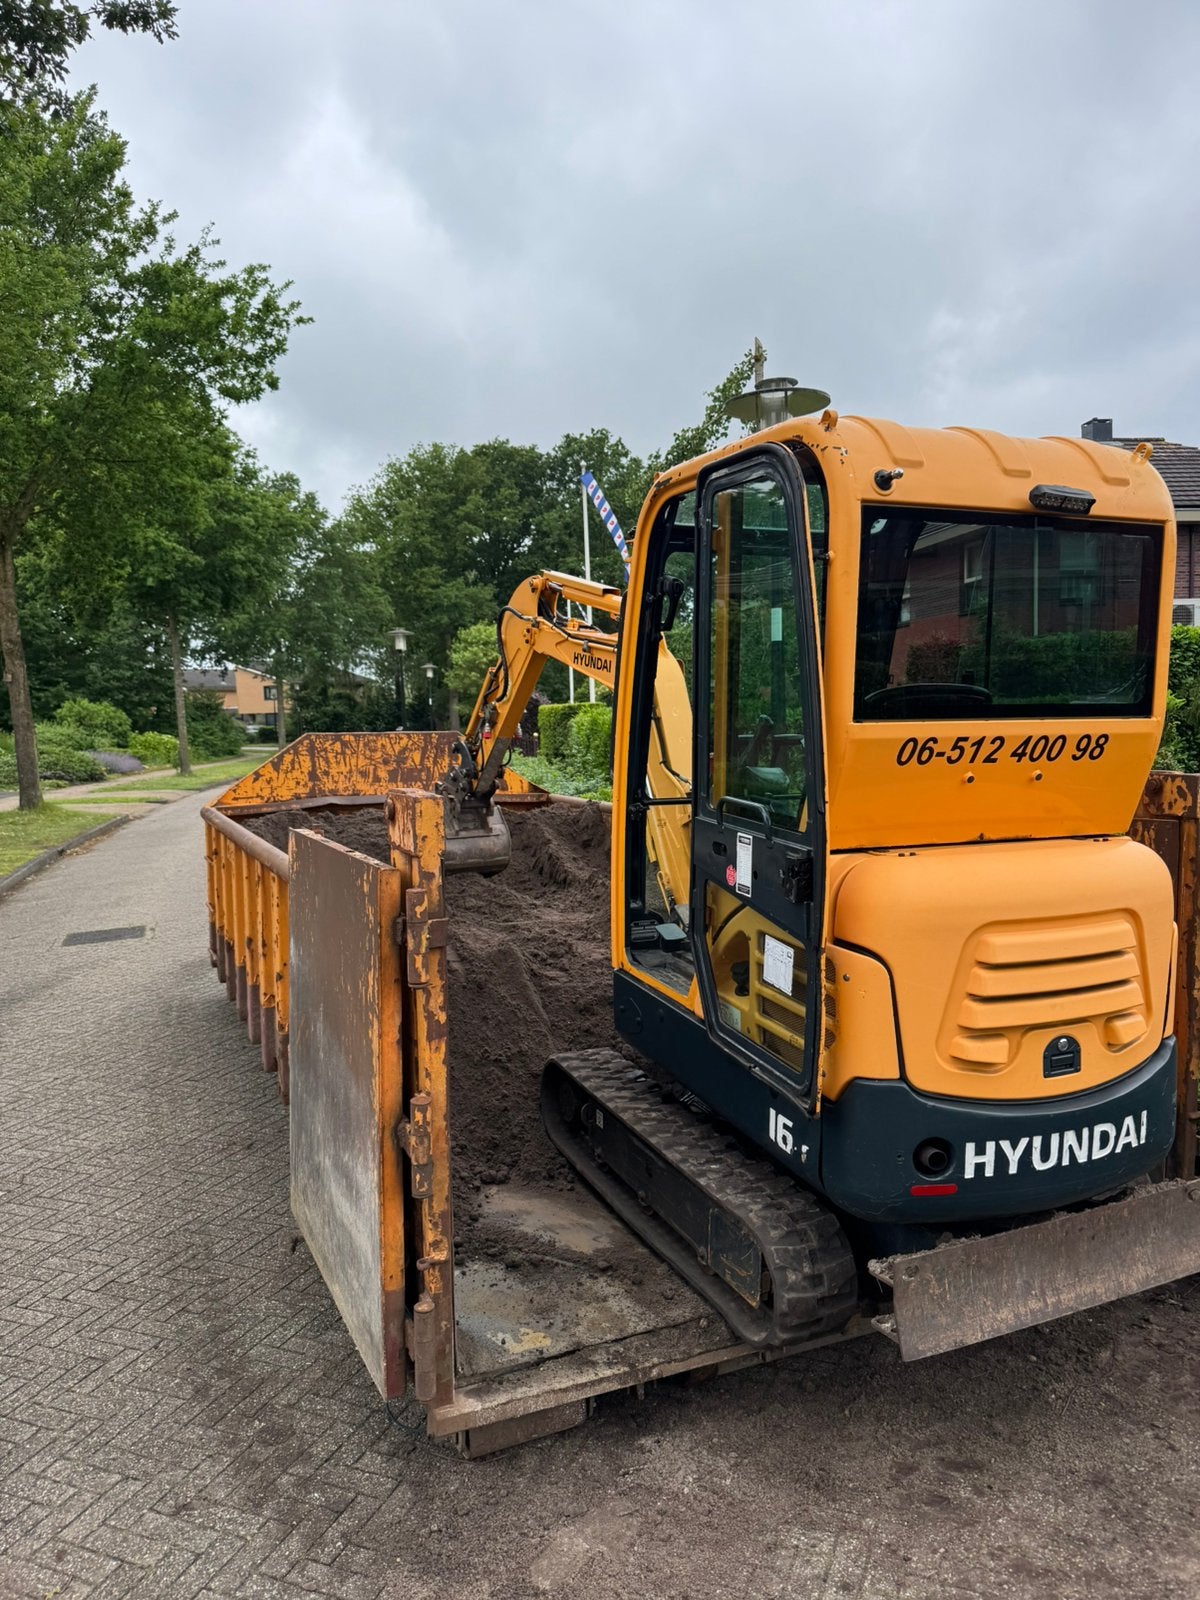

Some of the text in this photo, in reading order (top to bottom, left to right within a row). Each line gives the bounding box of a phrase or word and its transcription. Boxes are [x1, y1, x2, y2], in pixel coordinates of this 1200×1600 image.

[573, 651, 612, 673] HYUNDAI
[896, 733, 1110, 767] 06-512 400 98
[964, 1110, 1148, 1179] HYUNDAI
